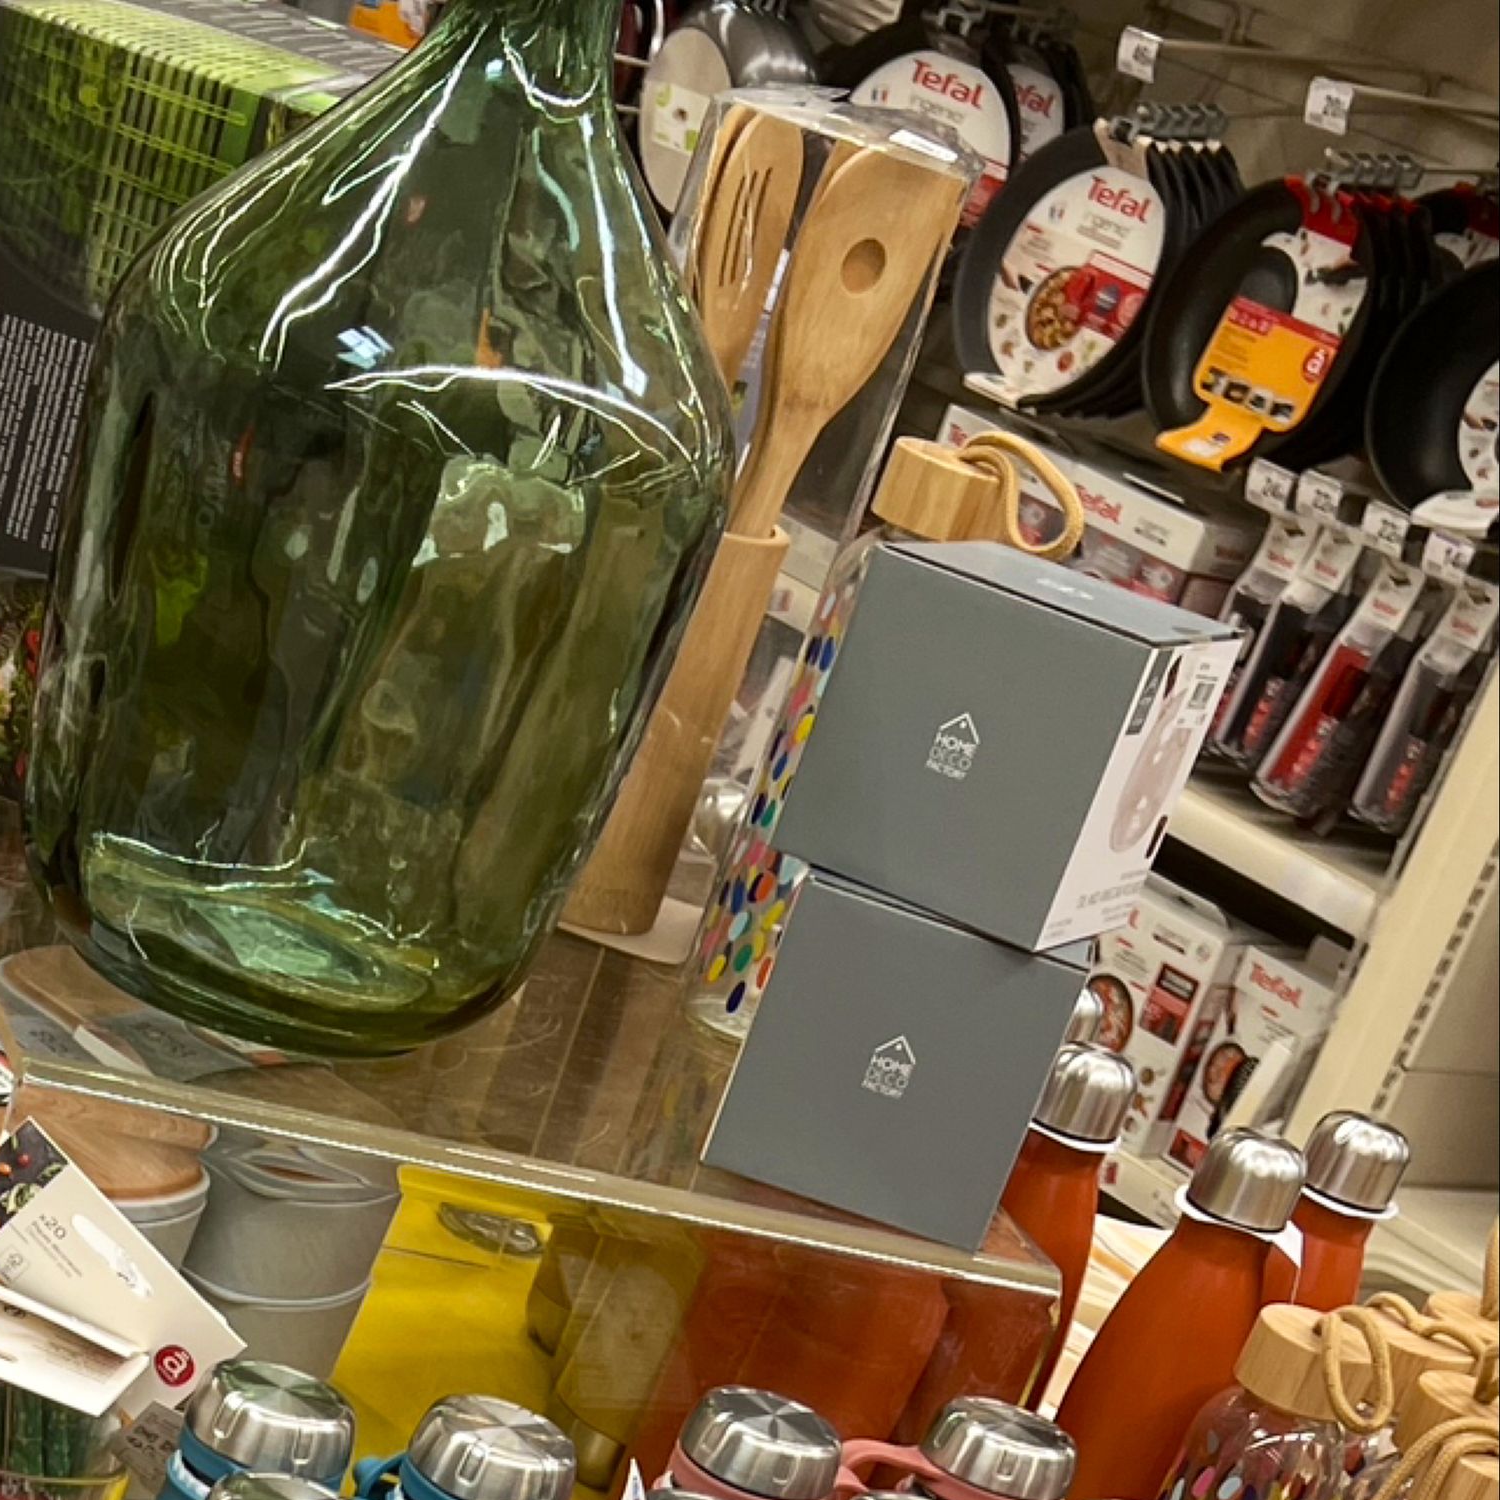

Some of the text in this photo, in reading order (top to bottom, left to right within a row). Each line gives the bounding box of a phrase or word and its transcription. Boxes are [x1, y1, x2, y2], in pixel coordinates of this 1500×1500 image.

[912, 58, 984, 110] Tefal
[1015, 84, 1054, 118] fal
[1088, 174, 1151, 223] Tefal
[1251, 961, 1303, 1009] Tefal
[39, 1213, 67, 1241] x20
